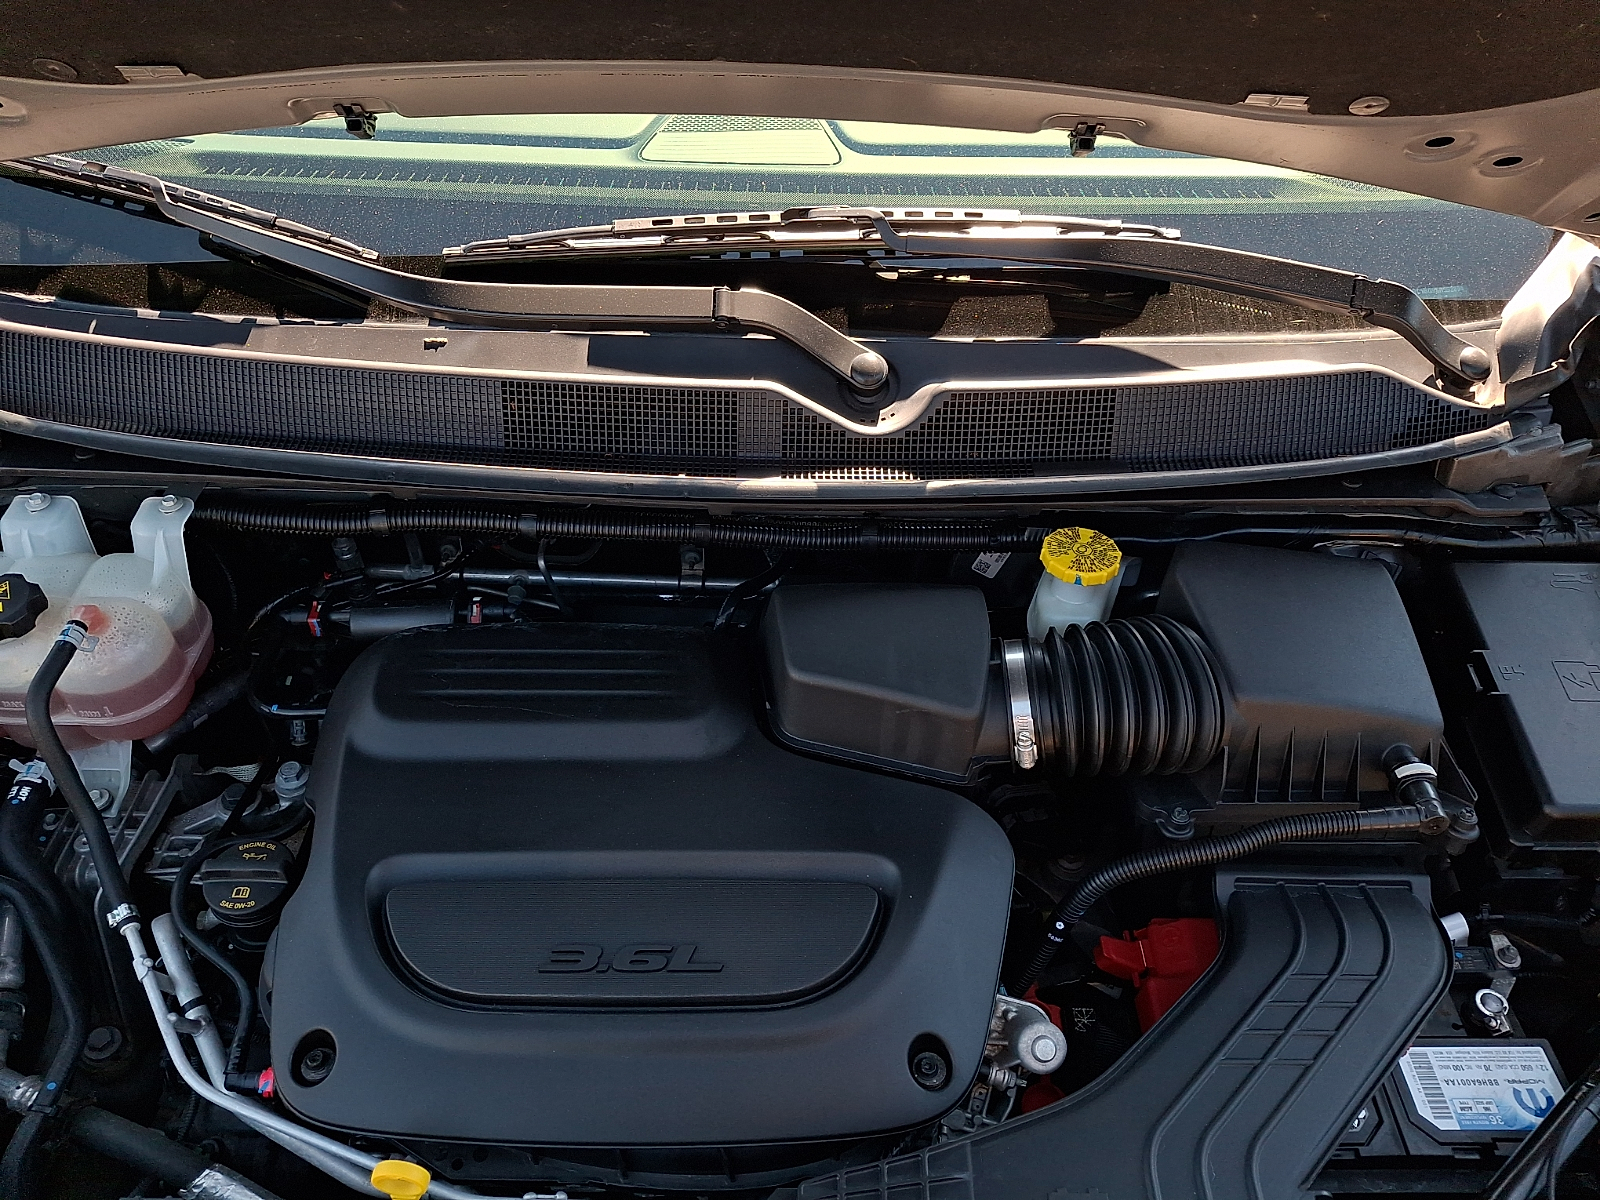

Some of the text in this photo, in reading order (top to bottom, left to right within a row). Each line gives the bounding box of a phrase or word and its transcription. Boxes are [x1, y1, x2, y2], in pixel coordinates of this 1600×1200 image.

[238, 841, 277, 851] ENGINE OIL
[219, 900, 256, 909] SAE 0W-20
[538, 943, 725, 973] 3.6L
[1444, 1078, 1500, 1087] BBH6A001AA
[1489, 1115, 1505, 1125] 36
